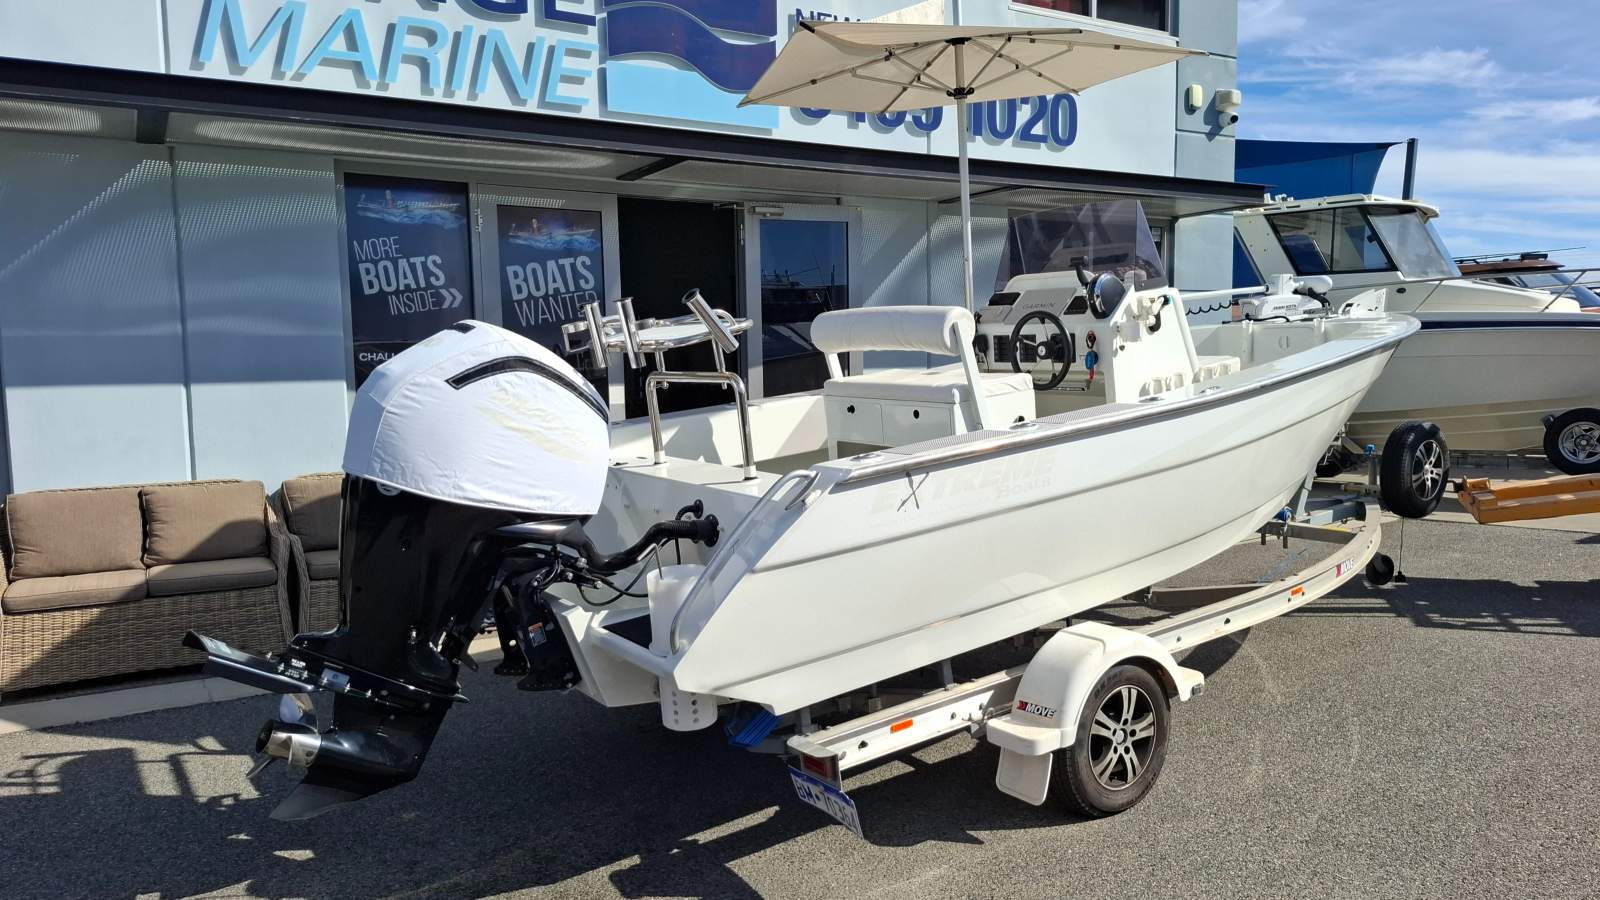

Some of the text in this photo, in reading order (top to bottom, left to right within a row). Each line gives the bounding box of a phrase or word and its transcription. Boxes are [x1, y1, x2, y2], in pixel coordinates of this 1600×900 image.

[199, 0, 599, 106] MARINE
[967, 93, 1078, 147] 1020
[354, 236, 402, 262] MORE
[358, 254, 446, 296] BOATS
[506, 255, 595, 301] BOATS
[388, 289, 442, 316] INSIDE
[1025, 703, 1055, 718] MOVE
